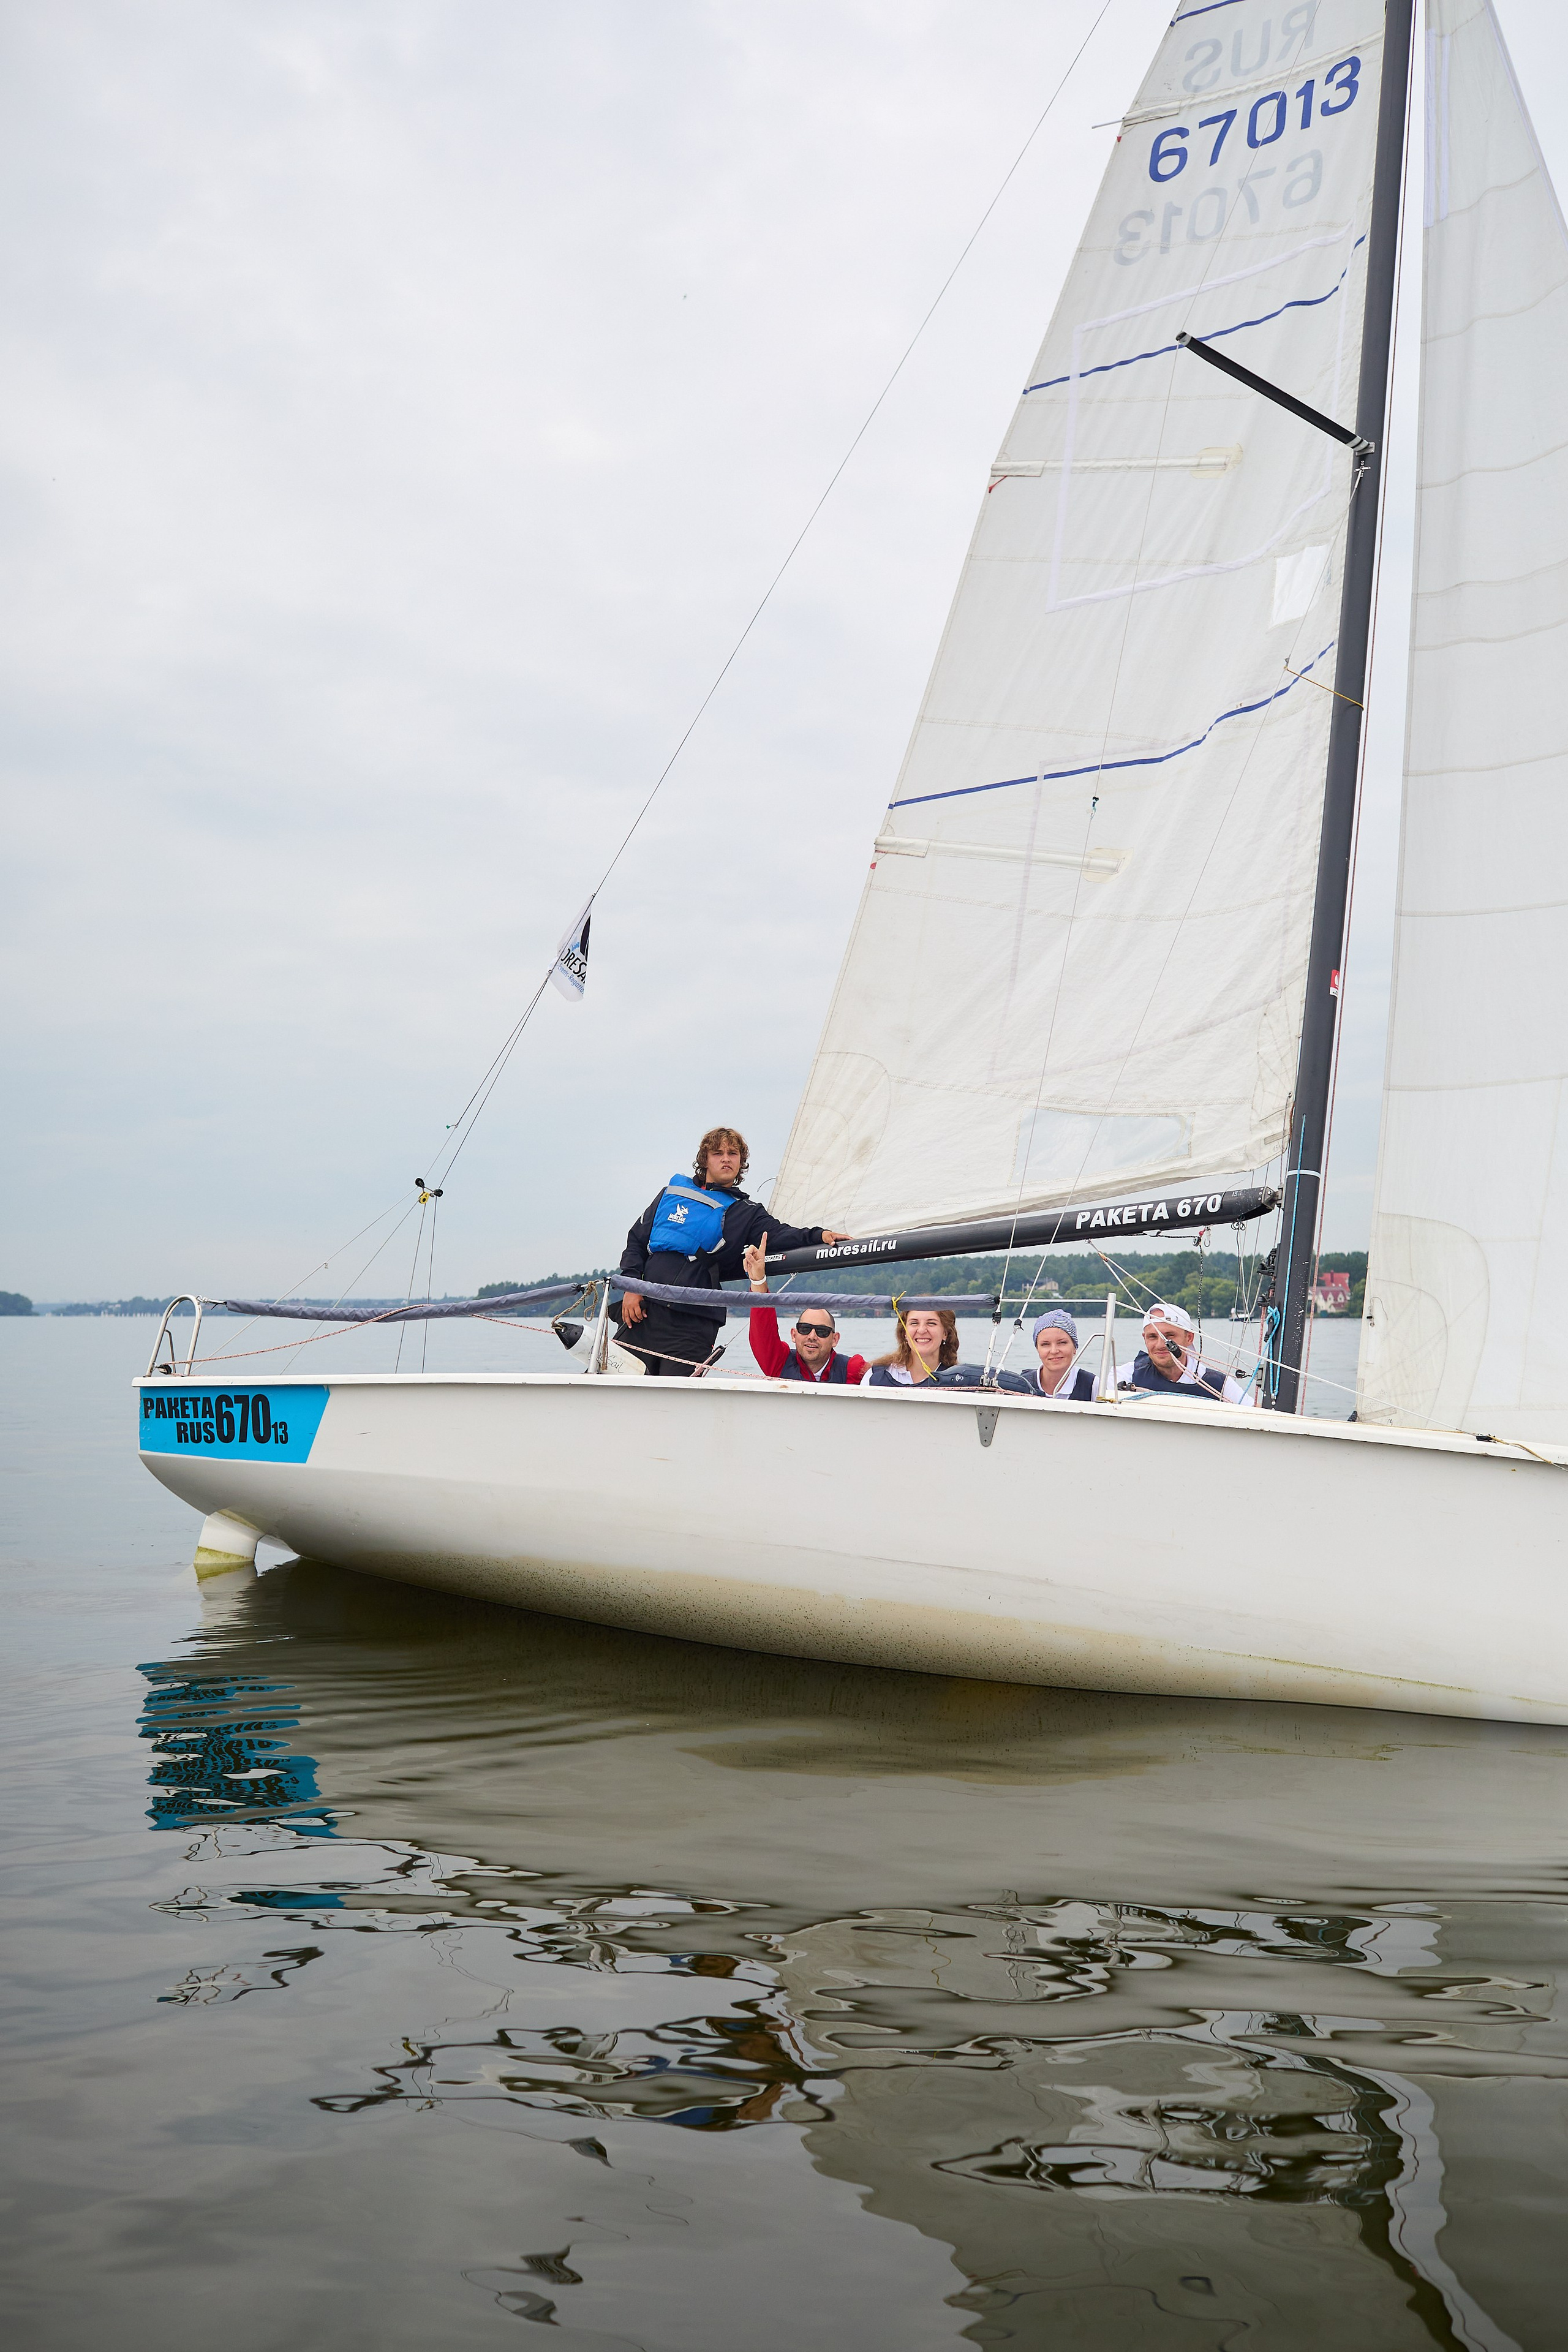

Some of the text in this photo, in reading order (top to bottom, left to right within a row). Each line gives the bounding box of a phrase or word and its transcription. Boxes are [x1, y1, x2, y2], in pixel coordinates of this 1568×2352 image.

[1148, 56, 1362, 183] 67013
[1177, 1194, 1222, 1218] 670
[815, 1239, 897, 1259] moresail.ru
[214, 1393, 271, 1444] 670
[271, 1421, 288, 1444] 13
[176, 1422, 215, 1444] RUS
